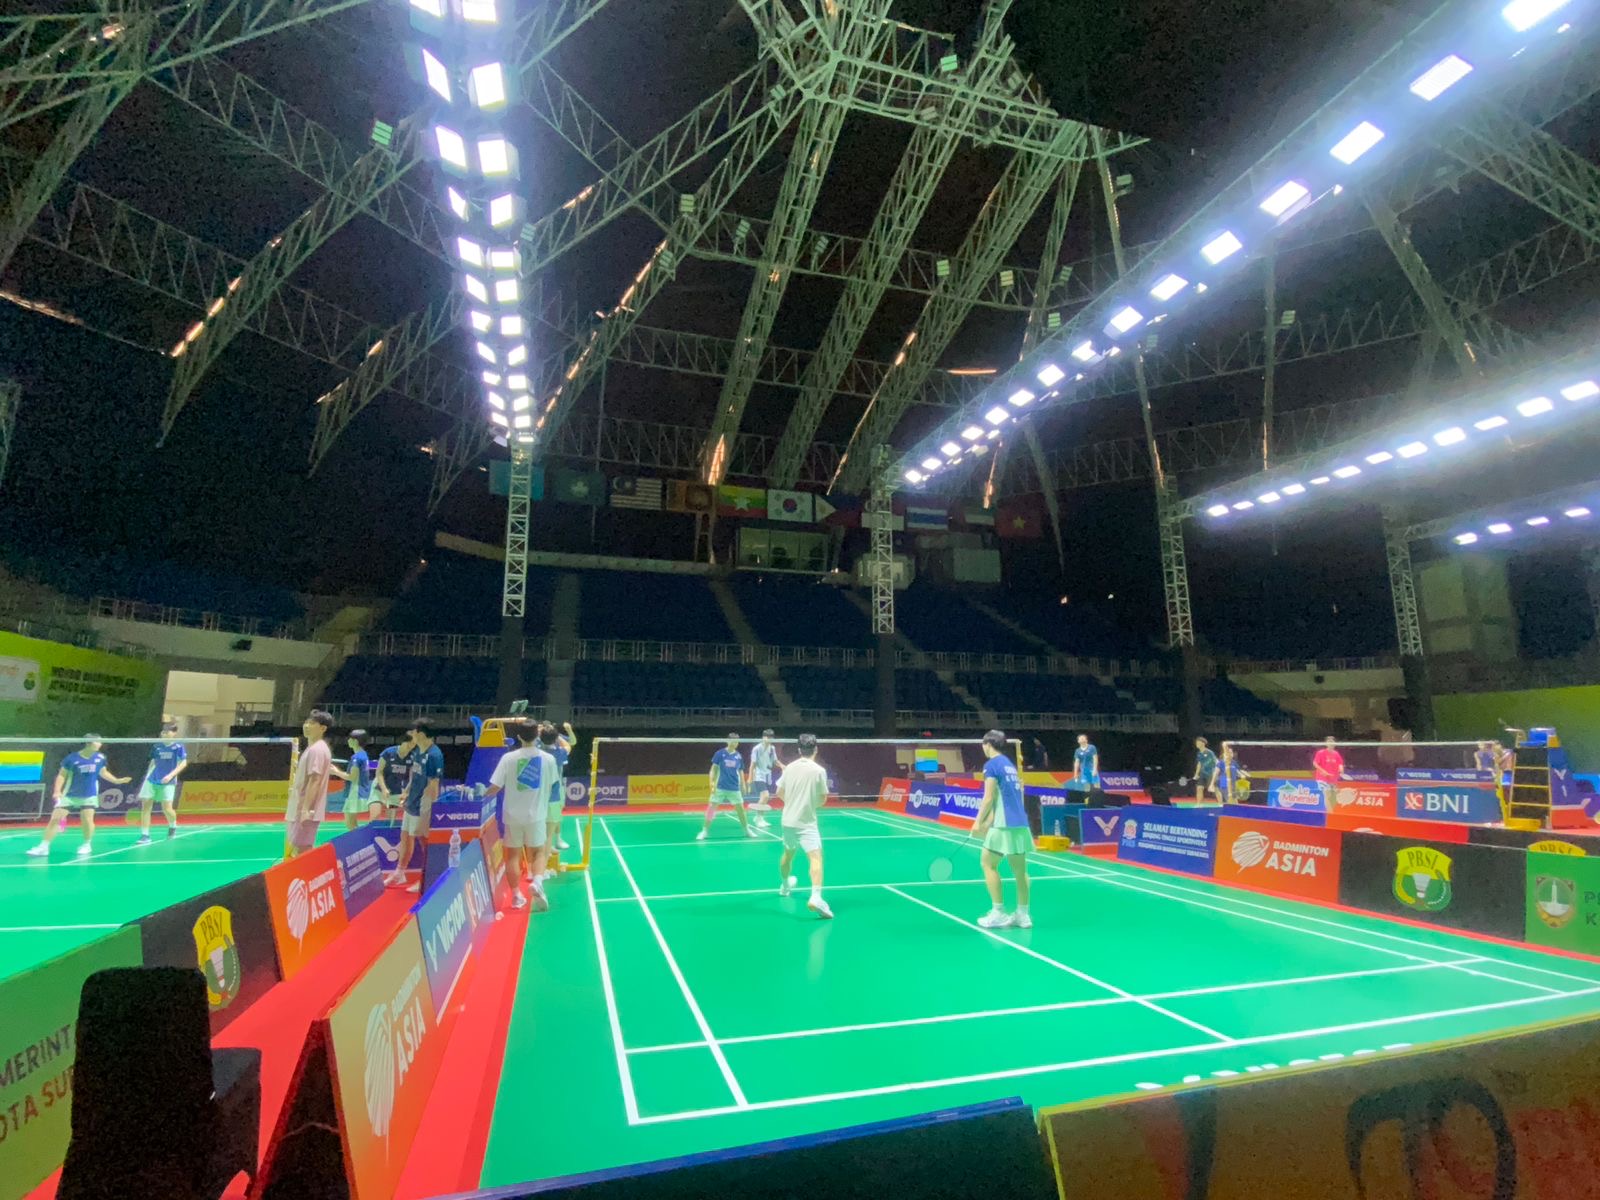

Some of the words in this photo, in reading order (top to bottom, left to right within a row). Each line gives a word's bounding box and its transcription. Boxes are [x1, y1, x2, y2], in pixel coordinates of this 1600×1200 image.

[632, 780, 681, 797] wondr
[1102, 777, 1139, 786] VICTOR
[185, 788, 253, 803] wondr
[1355, 797, 1384, 807] ASIA
[1426, 792, 1469, 814] BNI
[1273, 840, 1330, 857] BADMINTON
[1265, 852, 1317, 877] ASIA
[1407, 850, 1439, 870] PBSI
[310, 886, 336, 924] ASIA
[1584, 891, 1600, 906] P
[200, 910, 223, 945] PBSI
[436, 892, 466, 954] VICTOR
[397, 996, 427, 1087] ASIA
